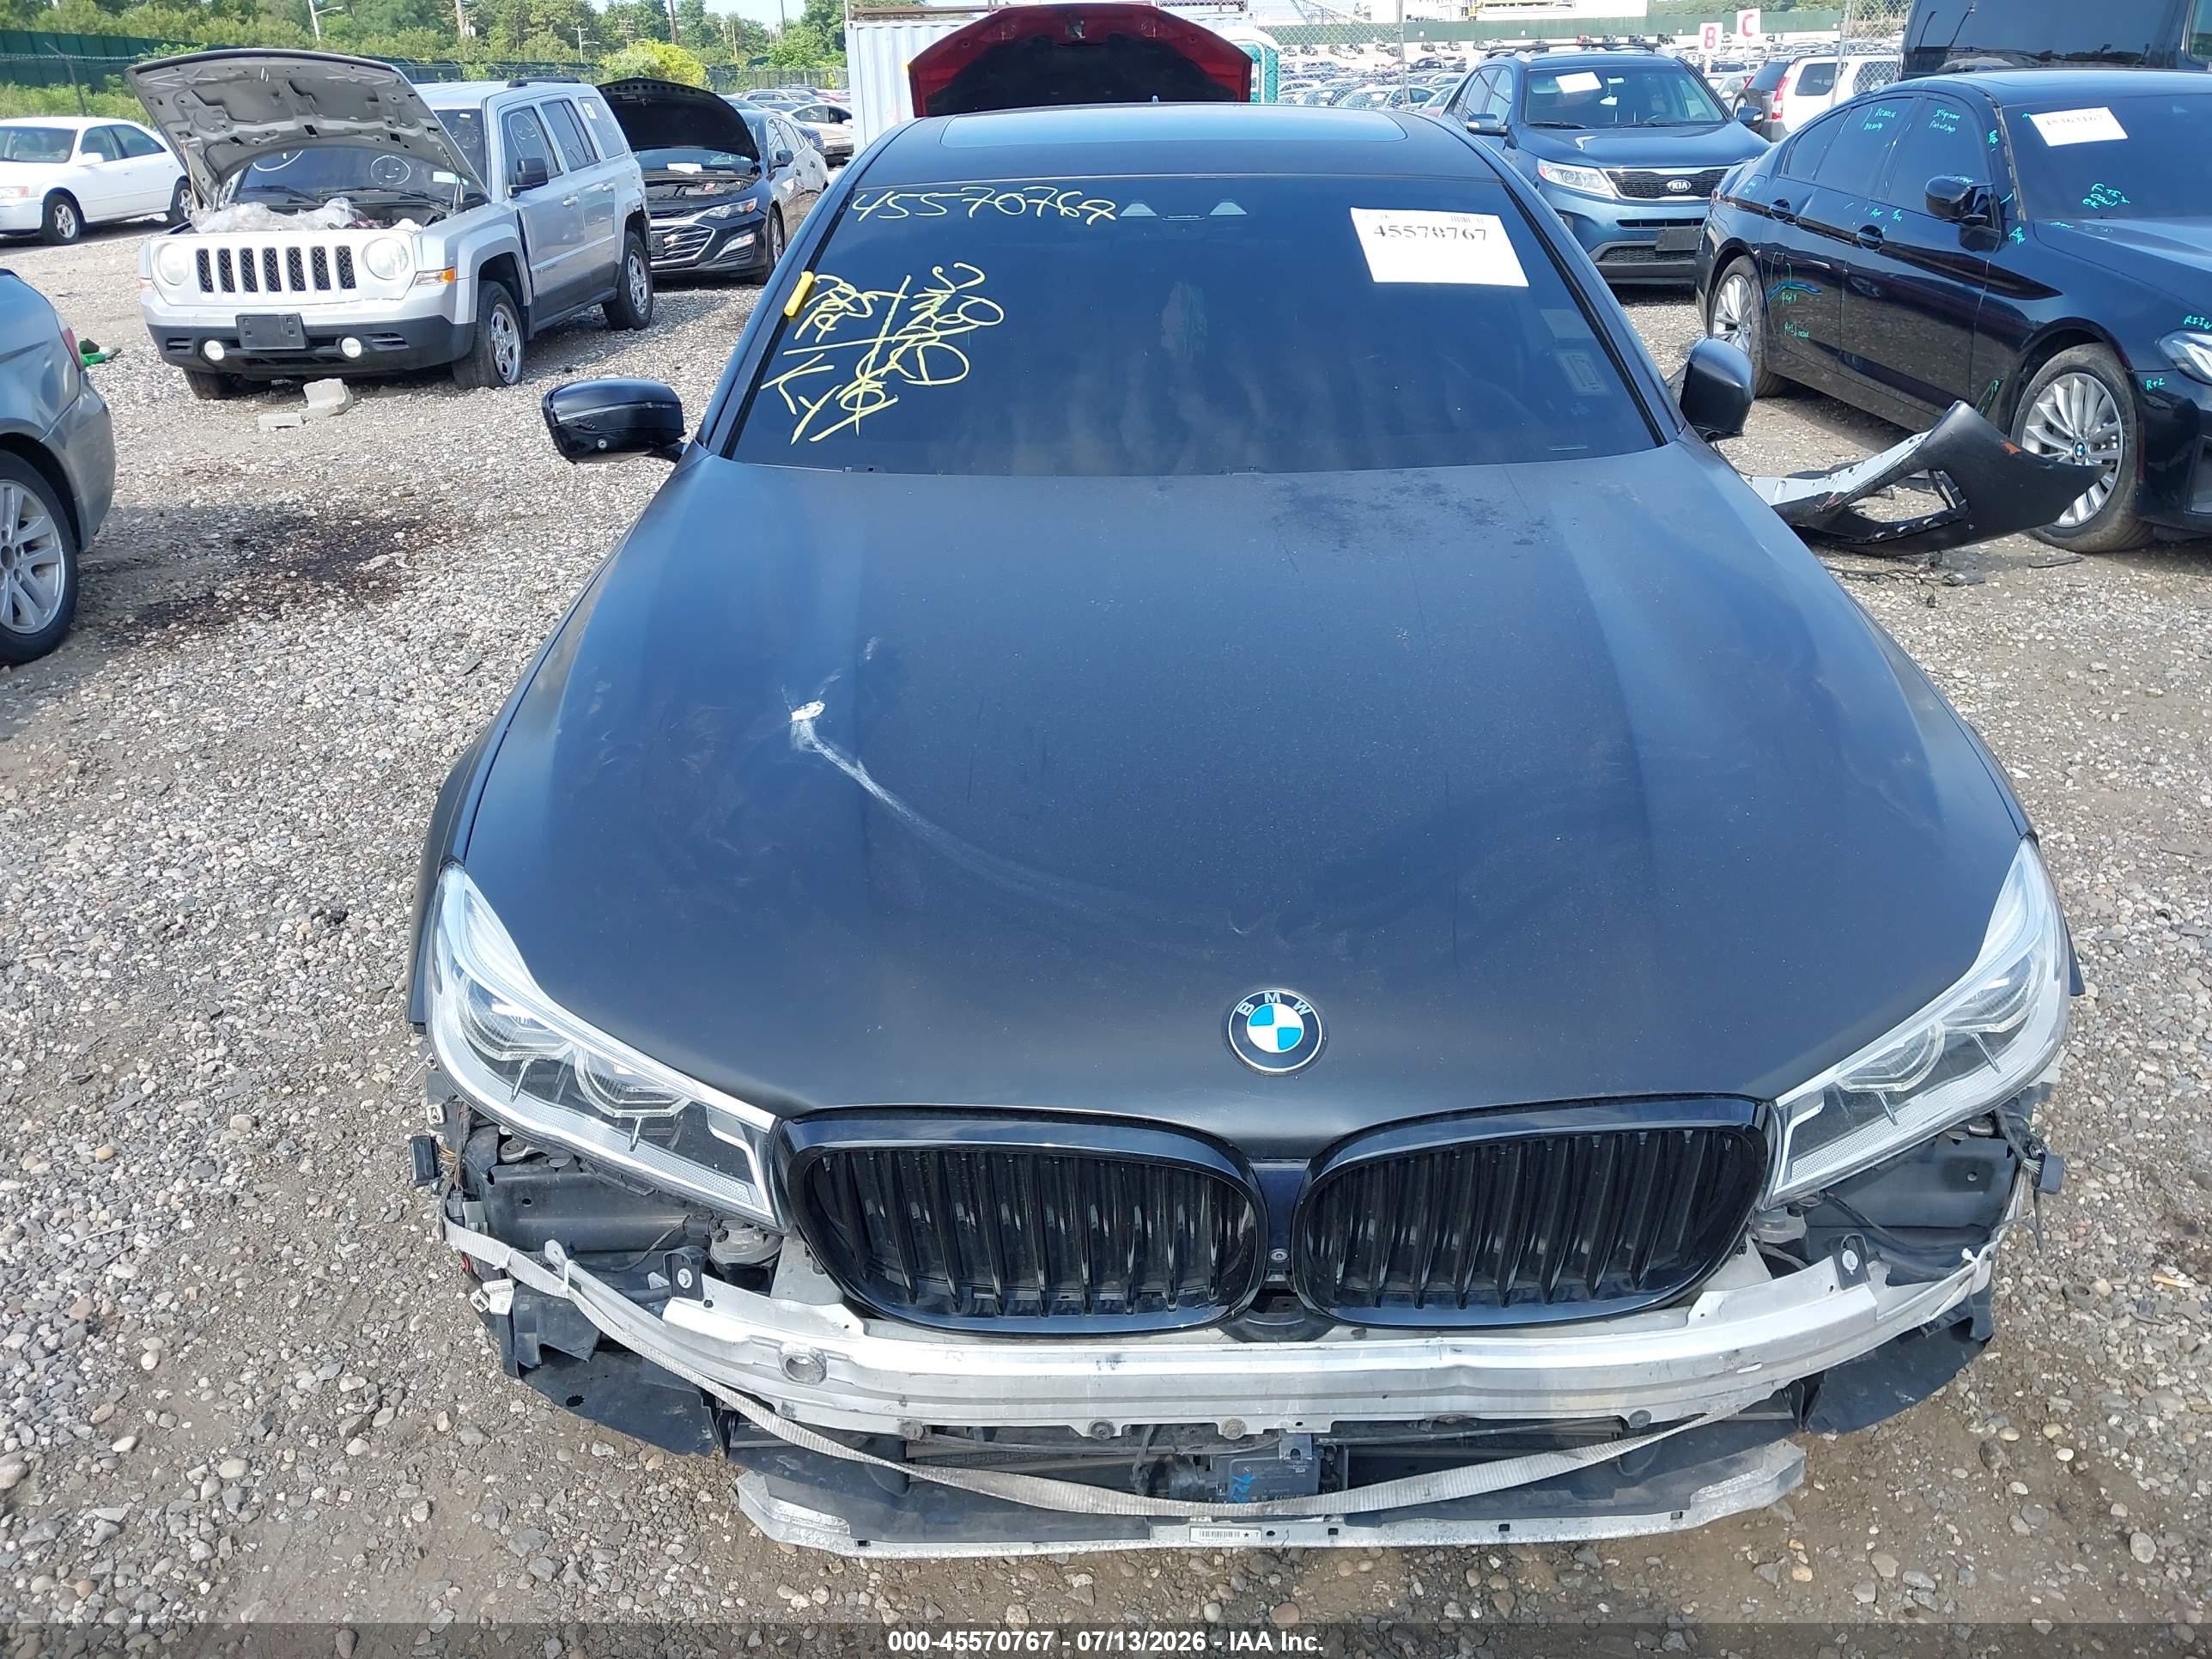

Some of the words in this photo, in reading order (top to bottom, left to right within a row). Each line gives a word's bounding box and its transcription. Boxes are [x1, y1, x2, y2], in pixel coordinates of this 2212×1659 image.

[1741, 14, 1754, 37] C
[1670, 180, 1689, 191] KIA
[1237, 992, 1312, 1017] BMW
